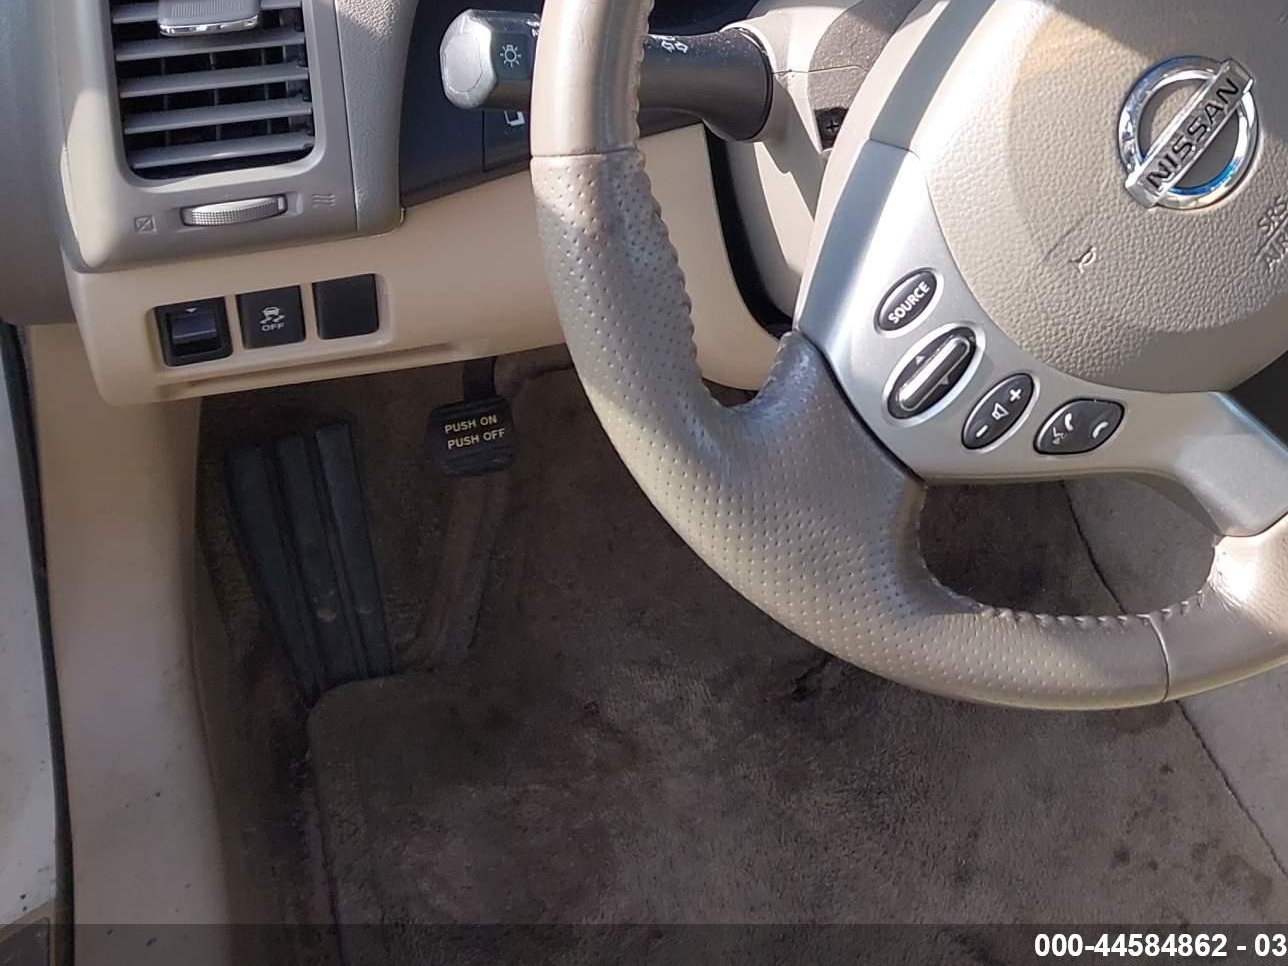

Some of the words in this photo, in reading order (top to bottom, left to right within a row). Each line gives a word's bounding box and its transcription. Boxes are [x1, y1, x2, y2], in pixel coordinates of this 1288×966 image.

[1146, 78, 1240, 189] NISSAN
[888, 280, 931, 325] SOURCE
[261, 322, 285, 332] OFF
[444, 419, 477, 434] PUSH
[480, 414, 498, 426] ON
[447, 434, 480, 450] PUSH
[483, 427, 505, 441] OFF
